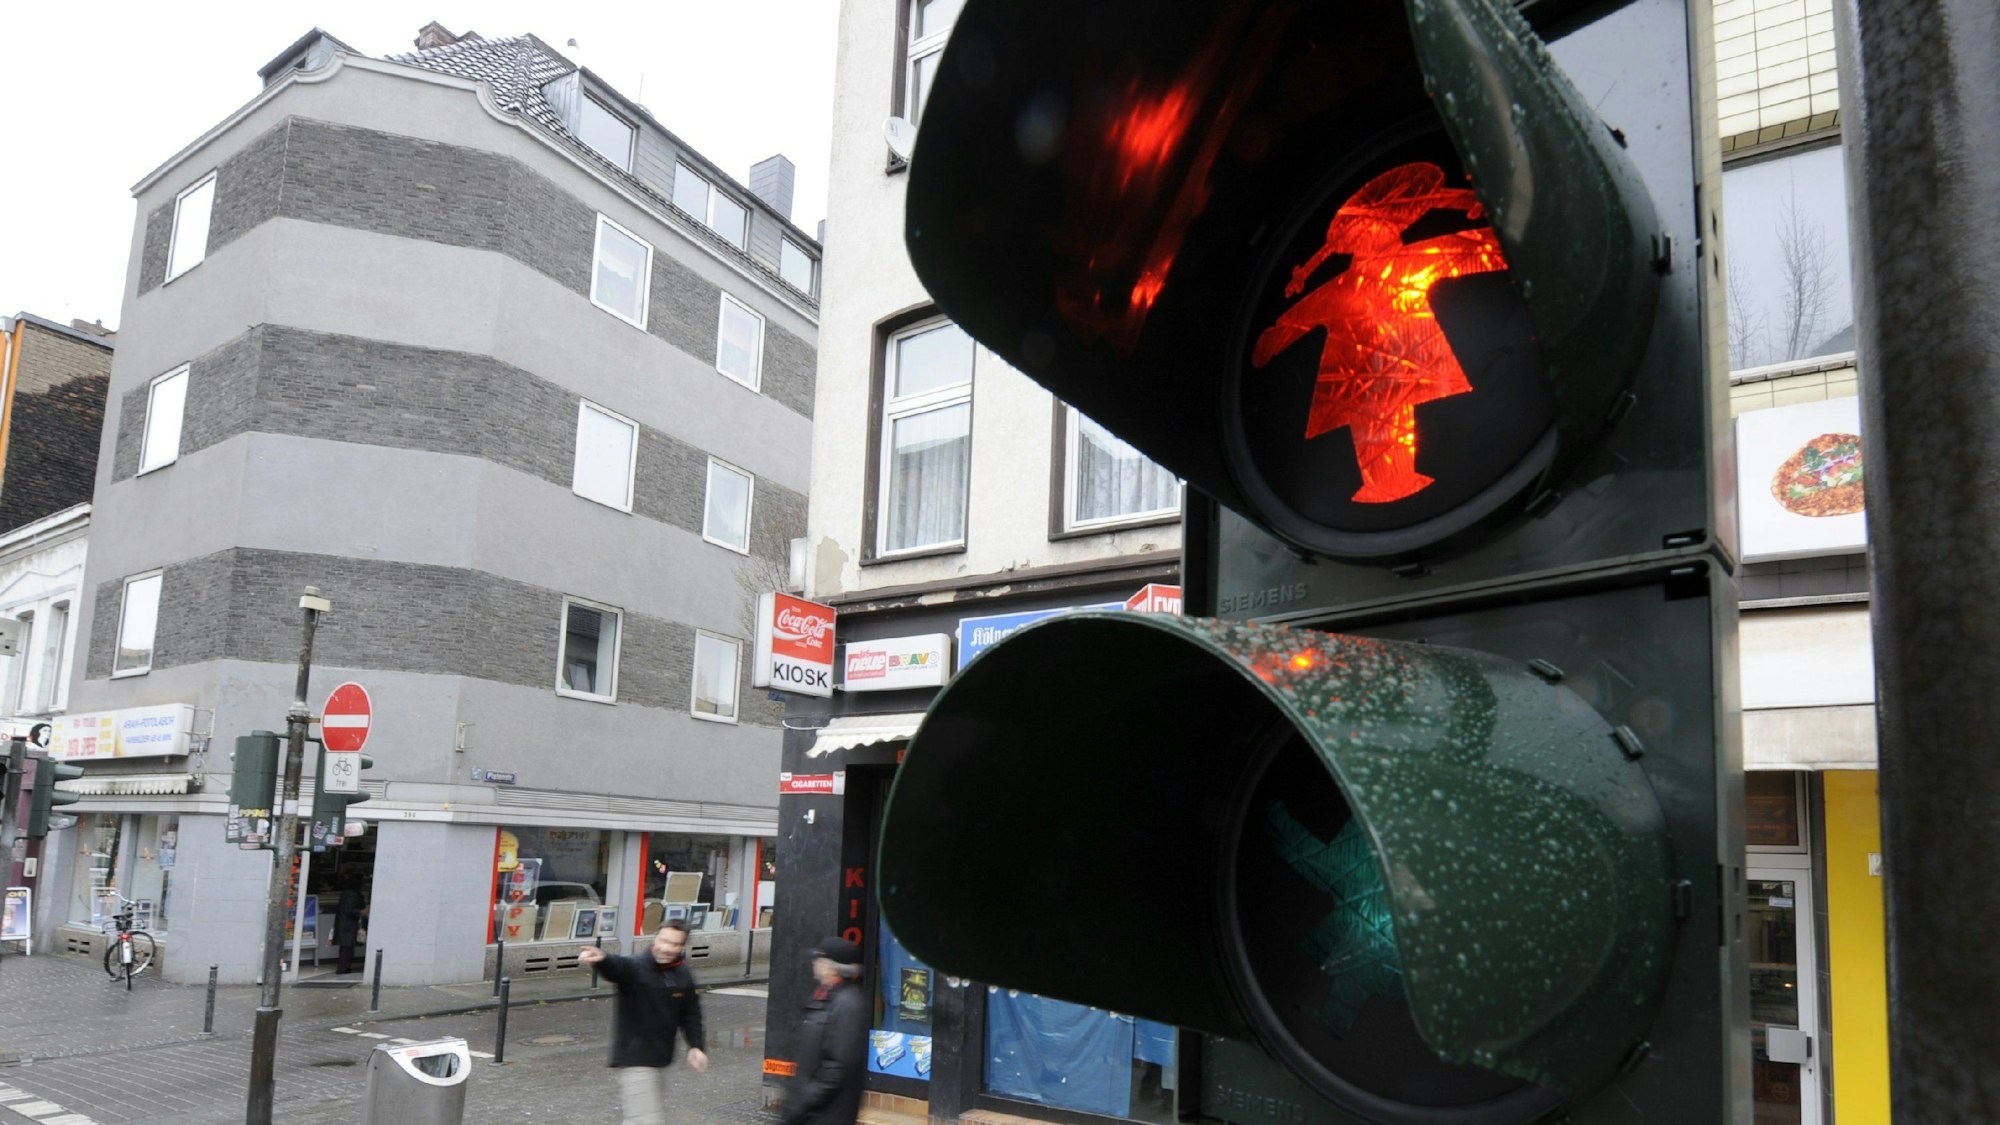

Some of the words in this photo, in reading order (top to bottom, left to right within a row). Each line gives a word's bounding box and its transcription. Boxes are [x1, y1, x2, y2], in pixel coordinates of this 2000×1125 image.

[1220, 582, 1307, 614] SIEMENS
[849, 655, 886, 672] neue
[889, 651, 940, 667] BRAVO
[773, 661, 828, 688] KIOSK
[791, 779, 832, 789] CIGARETTEN
